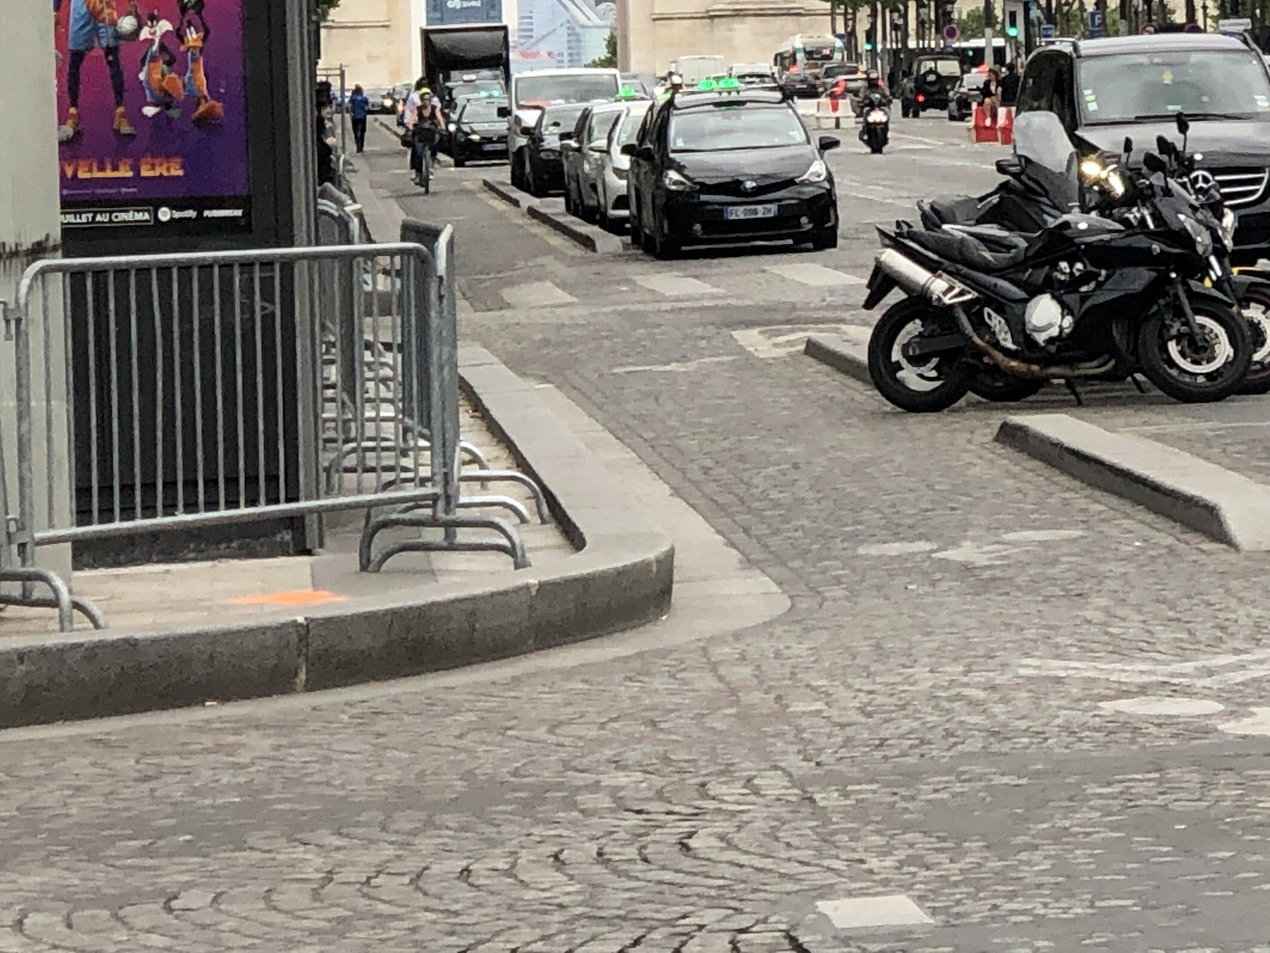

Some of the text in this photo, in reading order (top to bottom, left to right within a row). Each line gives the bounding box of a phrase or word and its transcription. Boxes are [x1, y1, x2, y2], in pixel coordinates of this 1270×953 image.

[95, 213, 110, 222] AU
[111, 210, 151, 222] CINÉMA
[171, 208, 198, 220] Spotify
